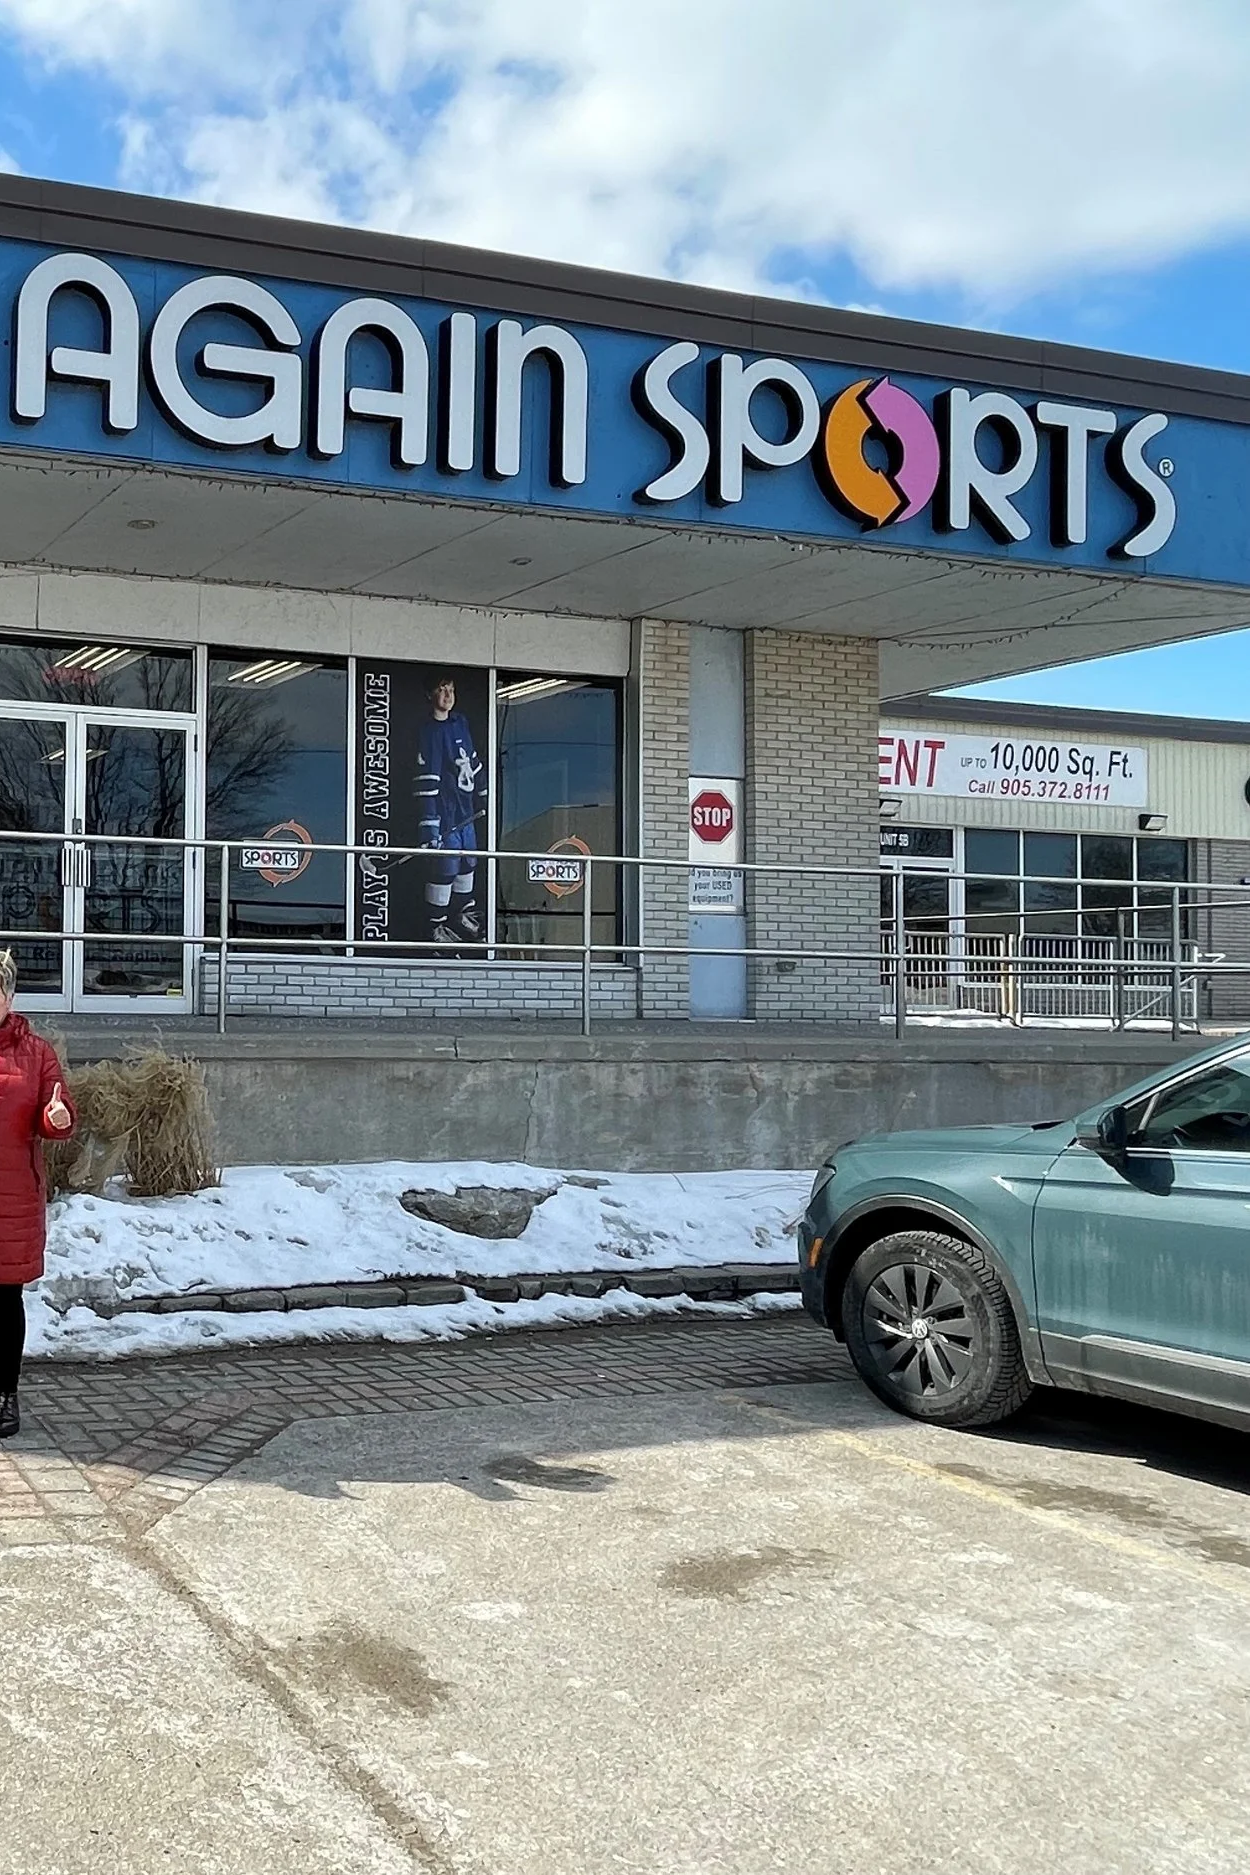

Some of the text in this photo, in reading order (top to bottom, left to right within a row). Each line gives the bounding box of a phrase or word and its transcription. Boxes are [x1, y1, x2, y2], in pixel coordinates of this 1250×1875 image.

[12, 252, 589, 489] AGAIN
[632, 340, 1177, 559] SPORTS
[363, 673, 390, 819] AWESOME
[878, 737, 945, 788] ENT
[960, 742, 1133, 782] UP TO 10,000 Sq. Ft.
[968, 778, 1110, 801] Call 905.372.8111
[693, 806, 731, 827] STOP
[244, 850, 297, 867] SPORTS
[530, 864, 578, 879] SPORTS
[712, 880, 732, 890] USED
